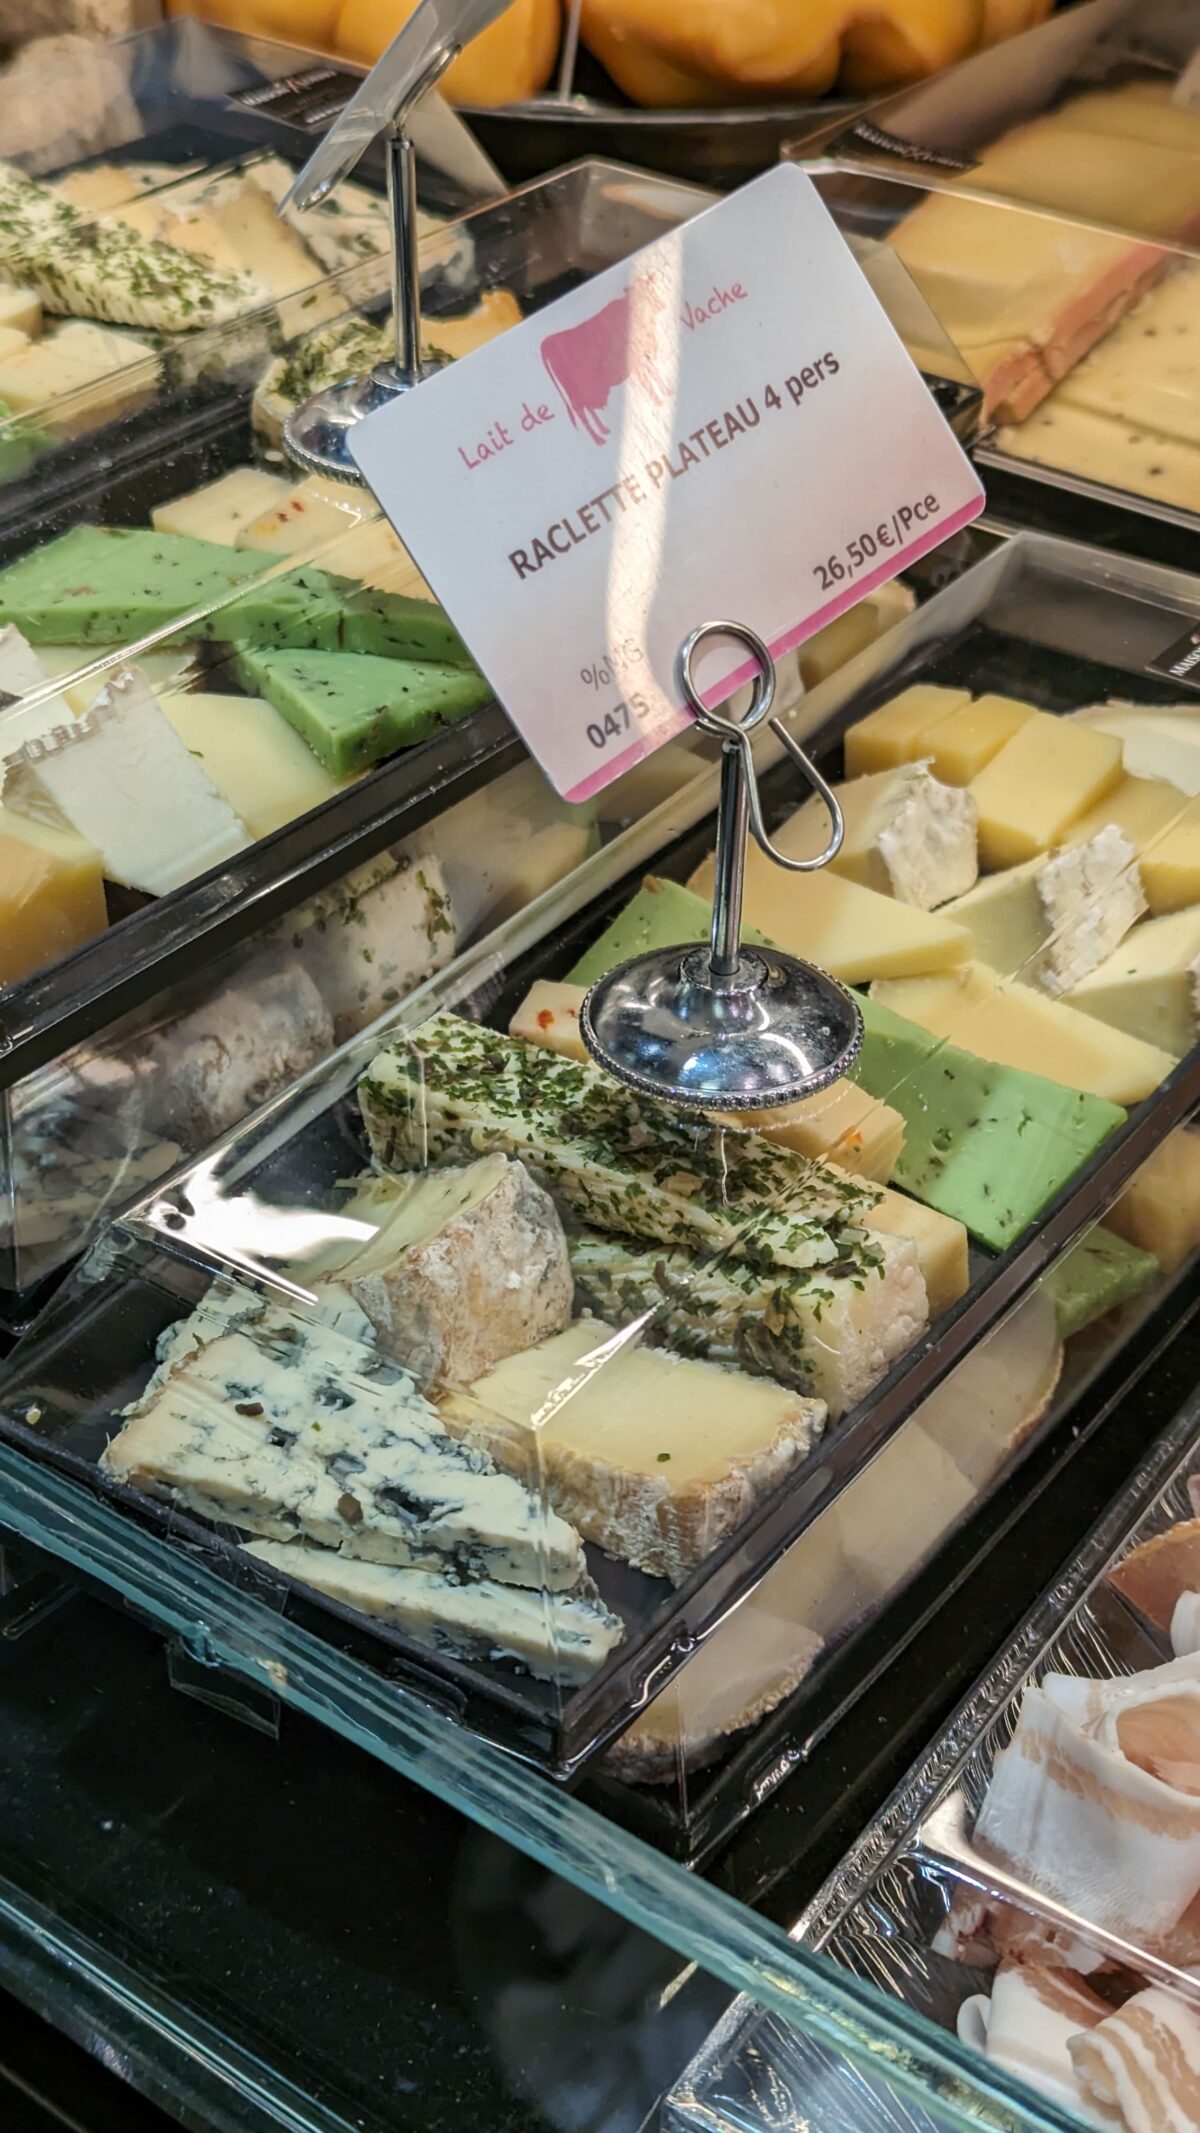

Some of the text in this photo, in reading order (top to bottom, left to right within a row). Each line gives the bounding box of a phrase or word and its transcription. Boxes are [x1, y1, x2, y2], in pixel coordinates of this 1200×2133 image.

[458, 279, 749, 469] Lait de Vache
[508, 350, 841, 581] RACLETTE PLATEAU 4 pers
[812, 490, 941, 592] 26,50€/Pce
[1169, 645, 1200, 676] MAISO
[586, 692, 650, 748] 0475
